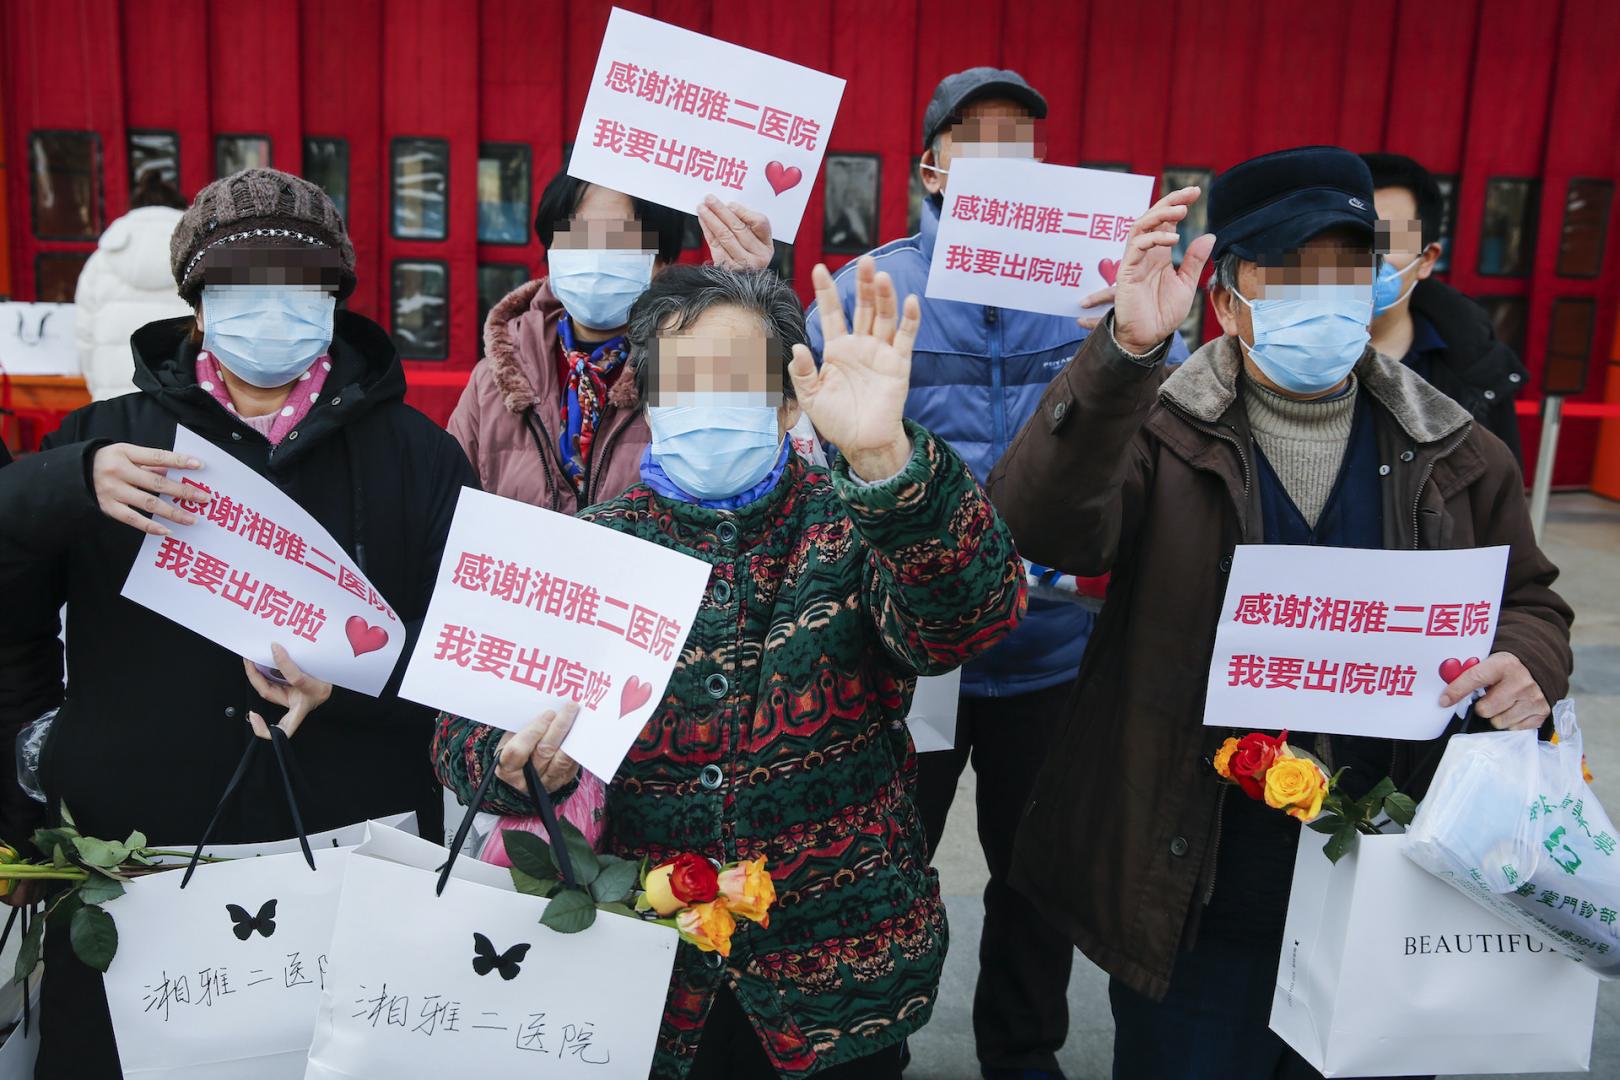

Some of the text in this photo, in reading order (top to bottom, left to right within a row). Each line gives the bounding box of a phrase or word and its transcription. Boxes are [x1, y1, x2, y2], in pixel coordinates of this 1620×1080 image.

[604, 61, 820, 151] 感谢湘雅二医院
[592, 119, 748, 190] 我要出院啦
[952, 195, 1136, 242] 感谢湘雅二医院
[946, 245, 1083, 288] 我要出院啦
[154, 536, 328, 643] 我要出院啦
[451, 551, 681, 661] 感谢湘雅二医院
[1233, 593, 1491, 637] 感谢湘雅二医院
[434, 624, 611, 712] 我要出院啦
[1227, 654, 1417, 697] 我要出院啦
[1405, 933, 1557, 956] BEAUTIFU
[351, 983, 610, 1065] 湘雅二医院
